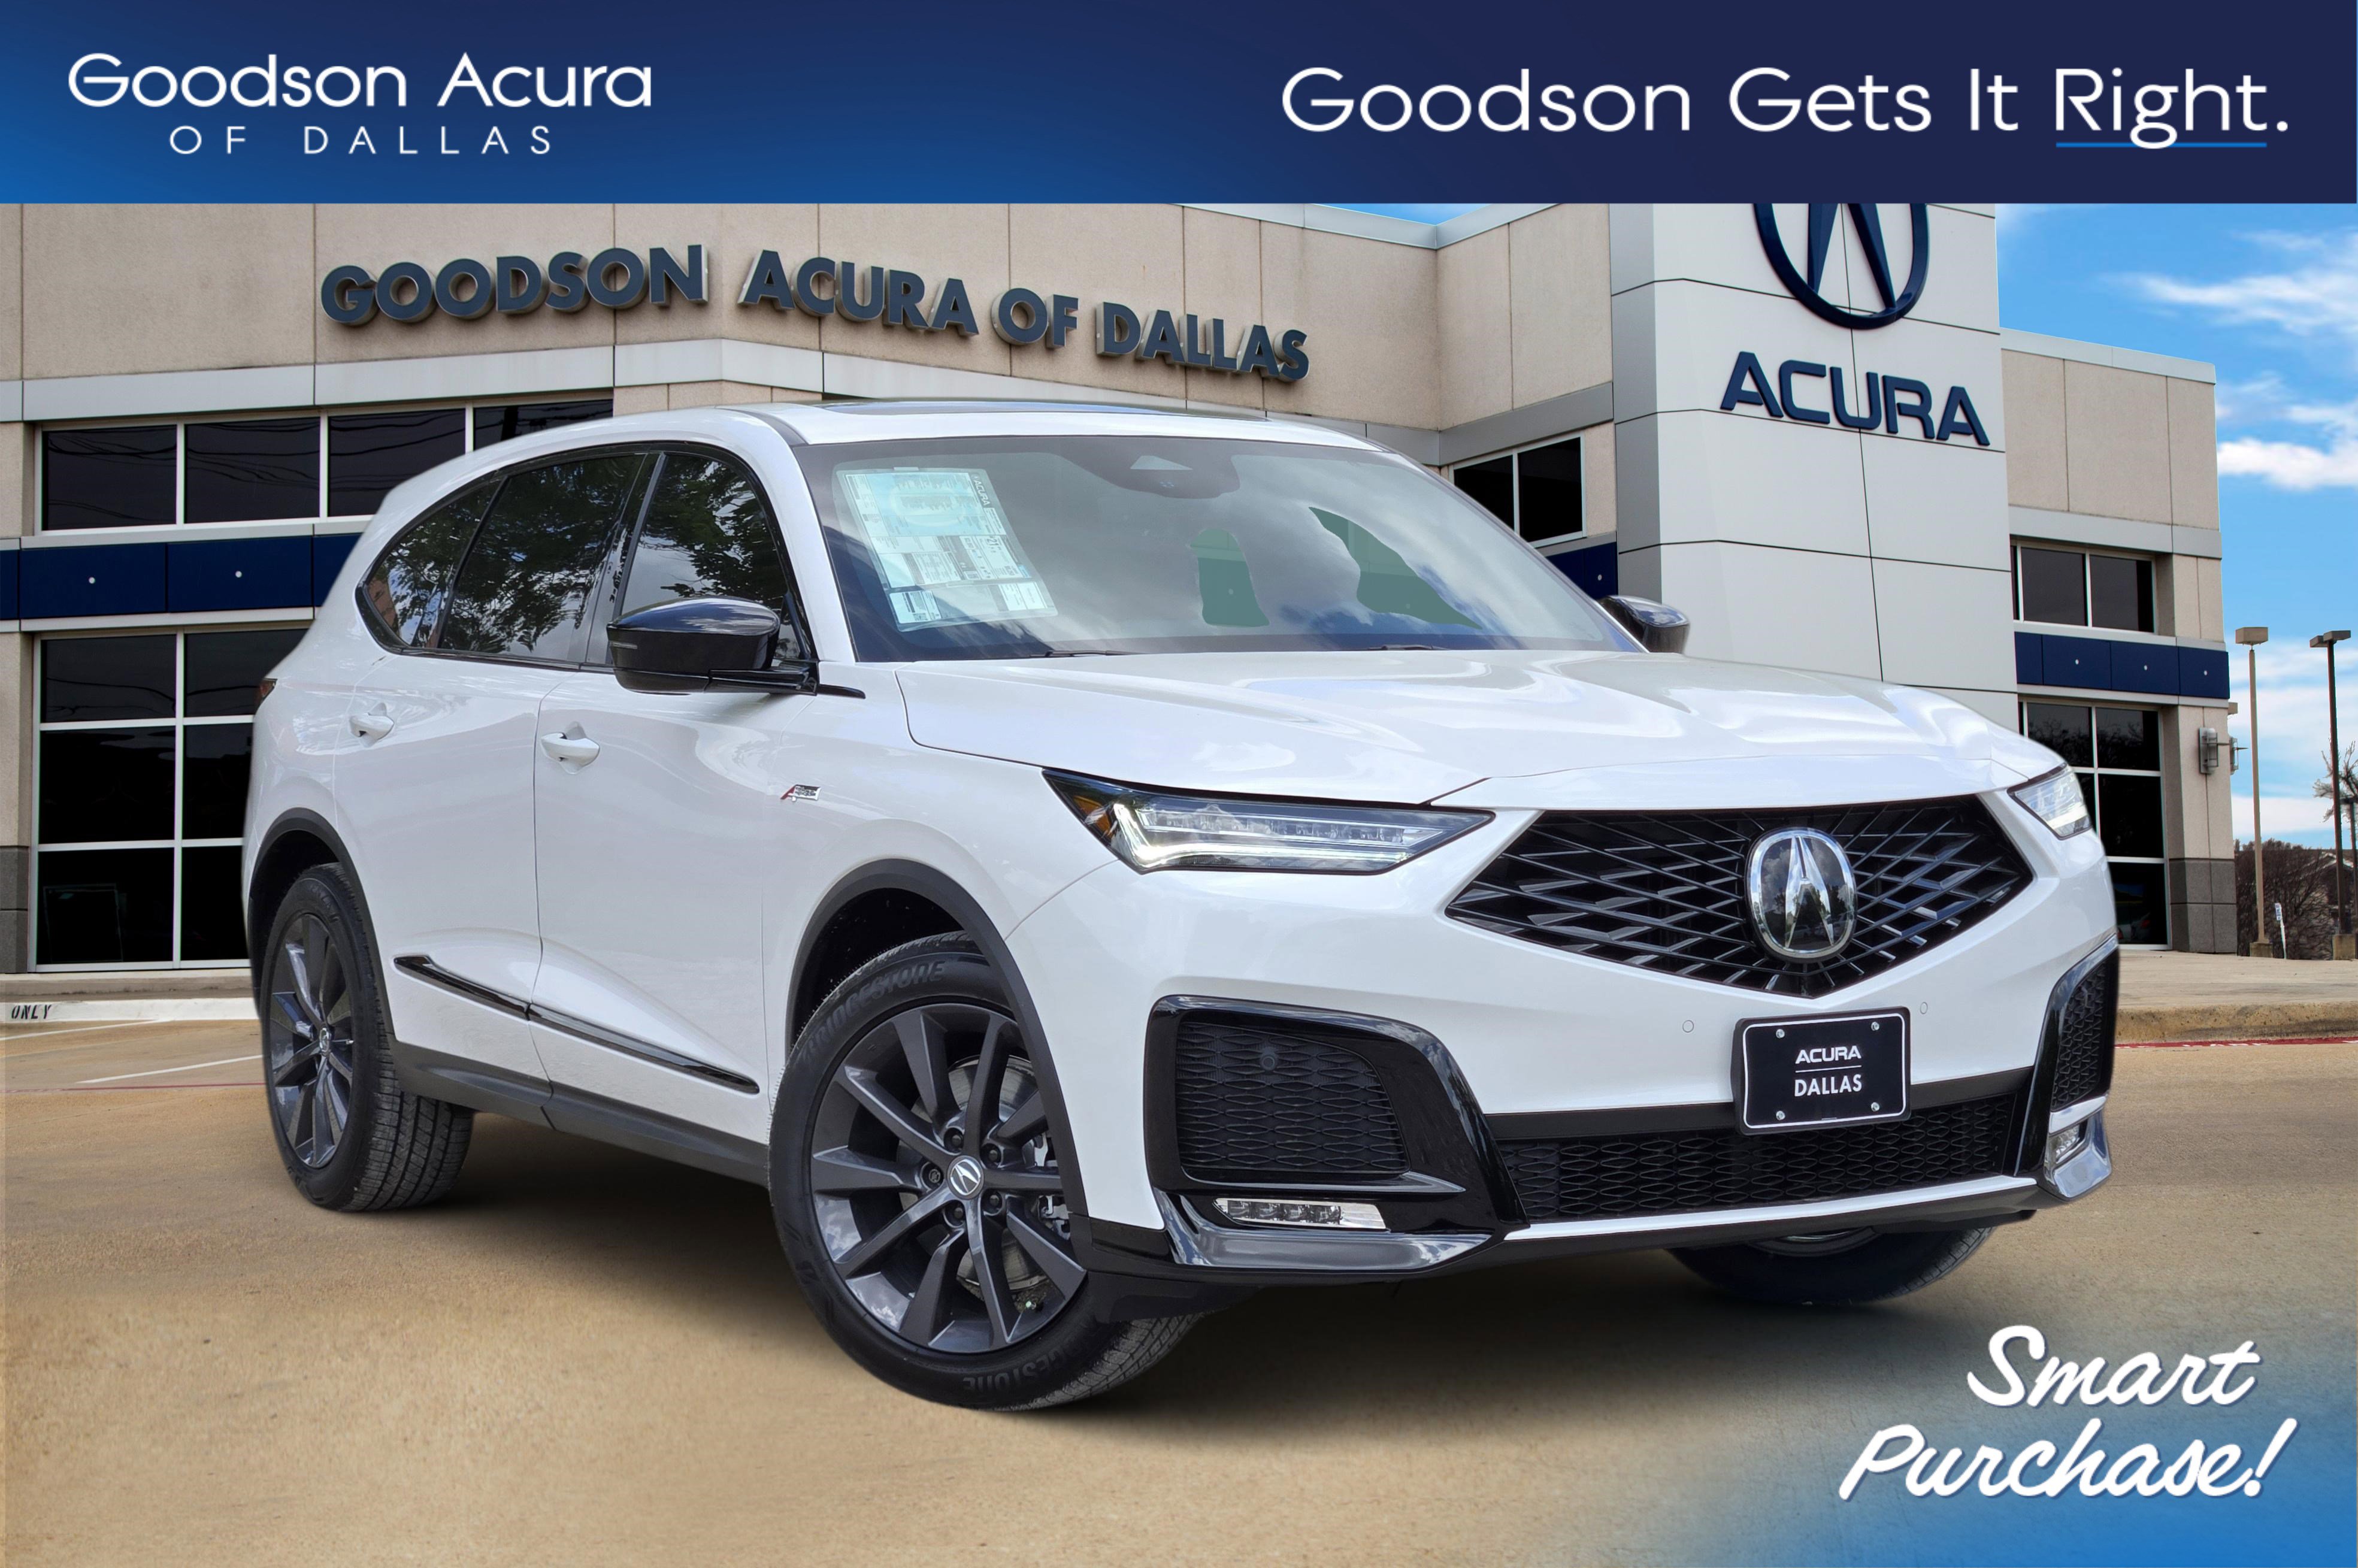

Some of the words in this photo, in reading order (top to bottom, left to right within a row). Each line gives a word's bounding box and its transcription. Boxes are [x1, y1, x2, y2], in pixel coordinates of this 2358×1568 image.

[320, 244, 709, 326] GOODSON
[738, 249, 979, 337] ACURA
[991, 287, 1079, 349] OF
[1095, 301, 1310, 383] DALLAS
[1720, 350, 1990, 446] ACURA
[974, 479, 991, 506] ACURA
[11, 1005, 52, 1019] ONLY
[1795, 1045, 1862, 1064] ACURA
[1794, 1074, 1862, 1097] DALLAS
